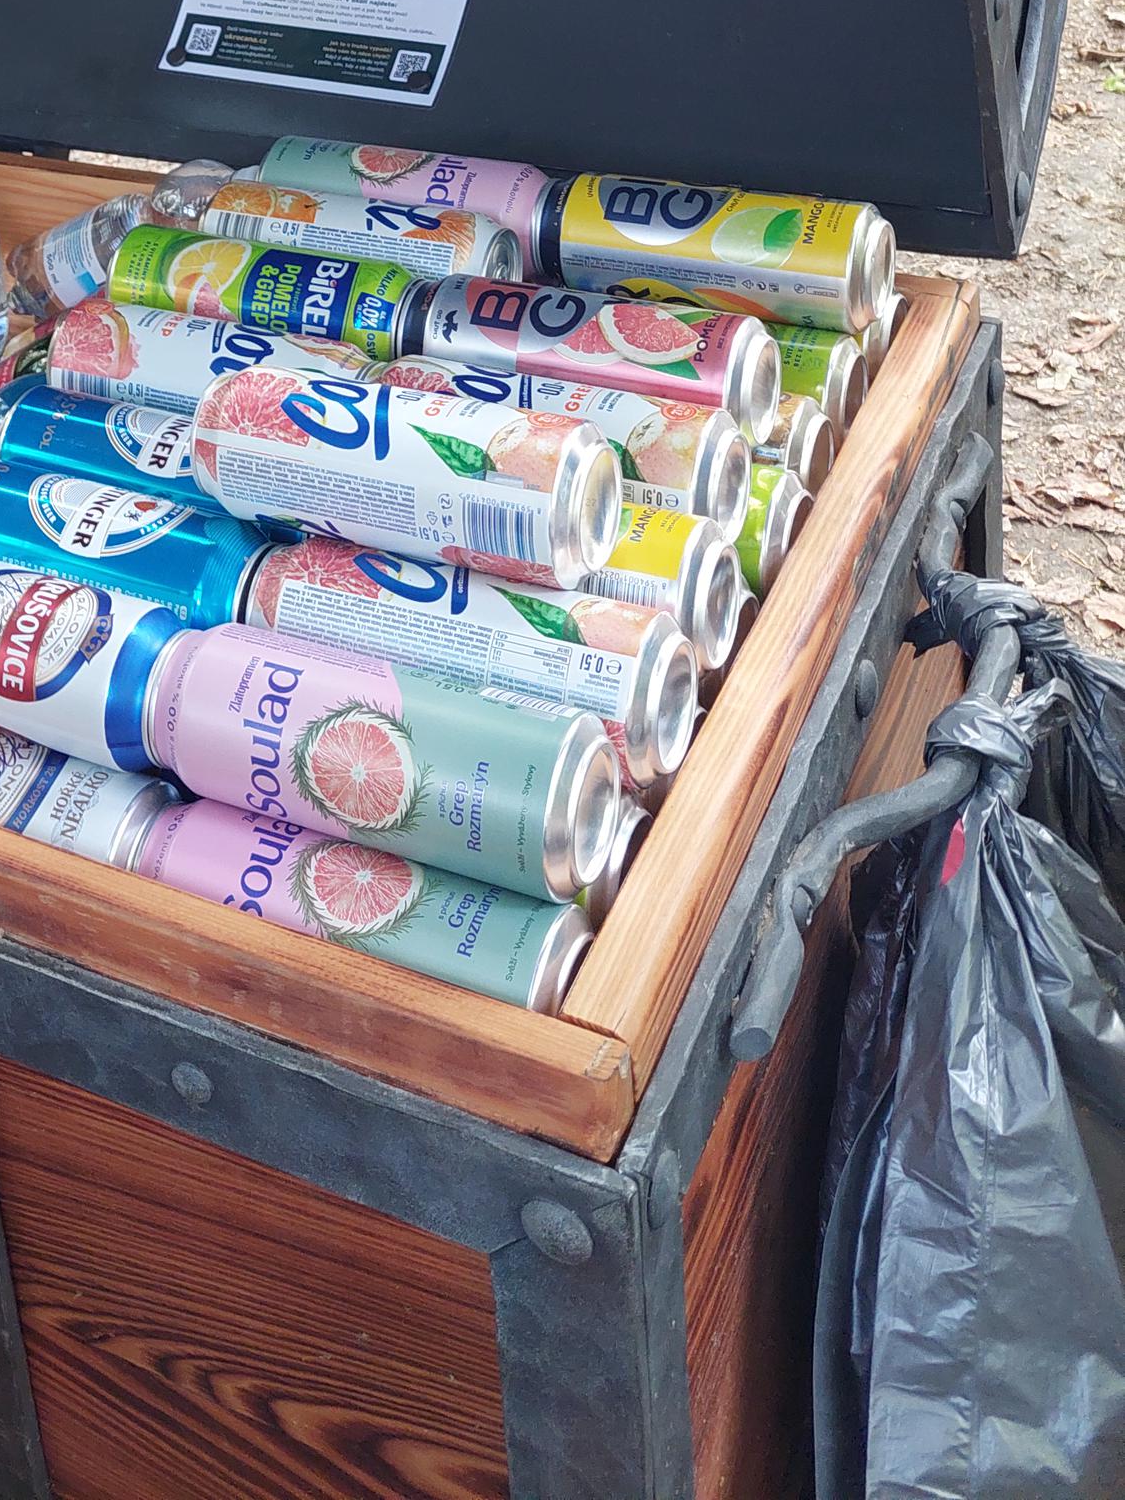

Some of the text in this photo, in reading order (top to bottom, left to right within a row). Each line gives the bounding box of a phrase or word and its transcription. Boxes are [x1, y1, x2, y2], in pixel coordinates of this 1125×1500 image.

[269, 263, 303, 332] POMELO
[360, 296, 383, 329] 0,0%
[376, 267, 401, 296] NEALKO
[1, 577, 77, 693] KRUŠOVICE
[228, 655, 261, 714] Zlatopramen
[242, 659, 305, 819] Soulad
[49, 770, 88, 822] HOŘKÉ
[60, 770, 110, 842] NEALKO
[448, 780, 469, 827] Grep
[465, 760, 491, 853] Rozmarýn
[447, 892, 477, 929] Grep
[456, 884, 504, 958] Rozmarýn
